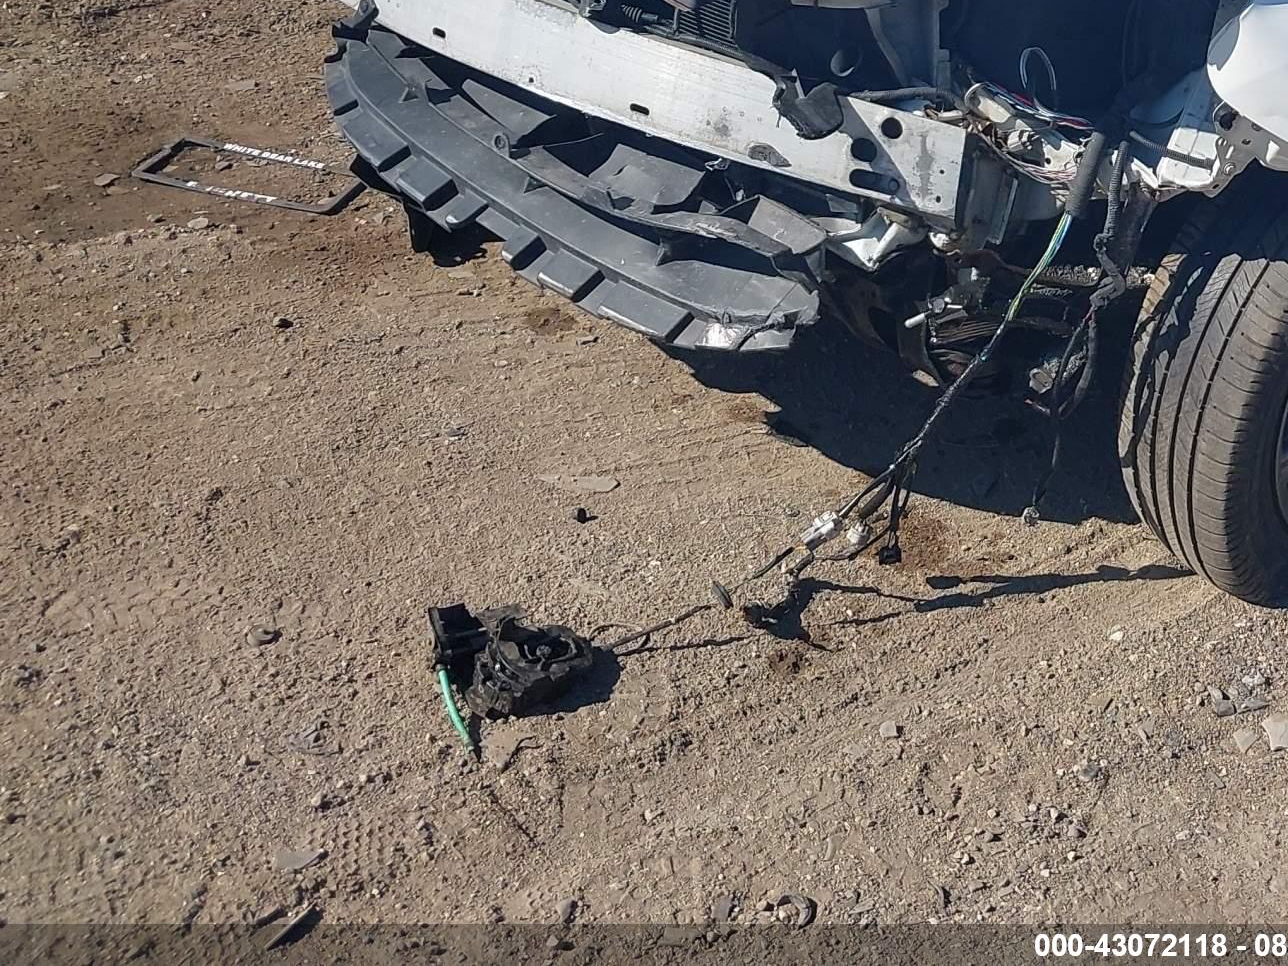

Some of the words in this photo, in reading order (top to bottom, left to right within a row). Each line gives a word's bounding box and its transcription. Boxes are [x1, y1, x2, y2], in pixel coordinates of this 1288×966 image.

[223, 143, 262, 156] WHITE
[262, 151, 293, 163] BEAR
[293, 158, 325, 169] LAKE
